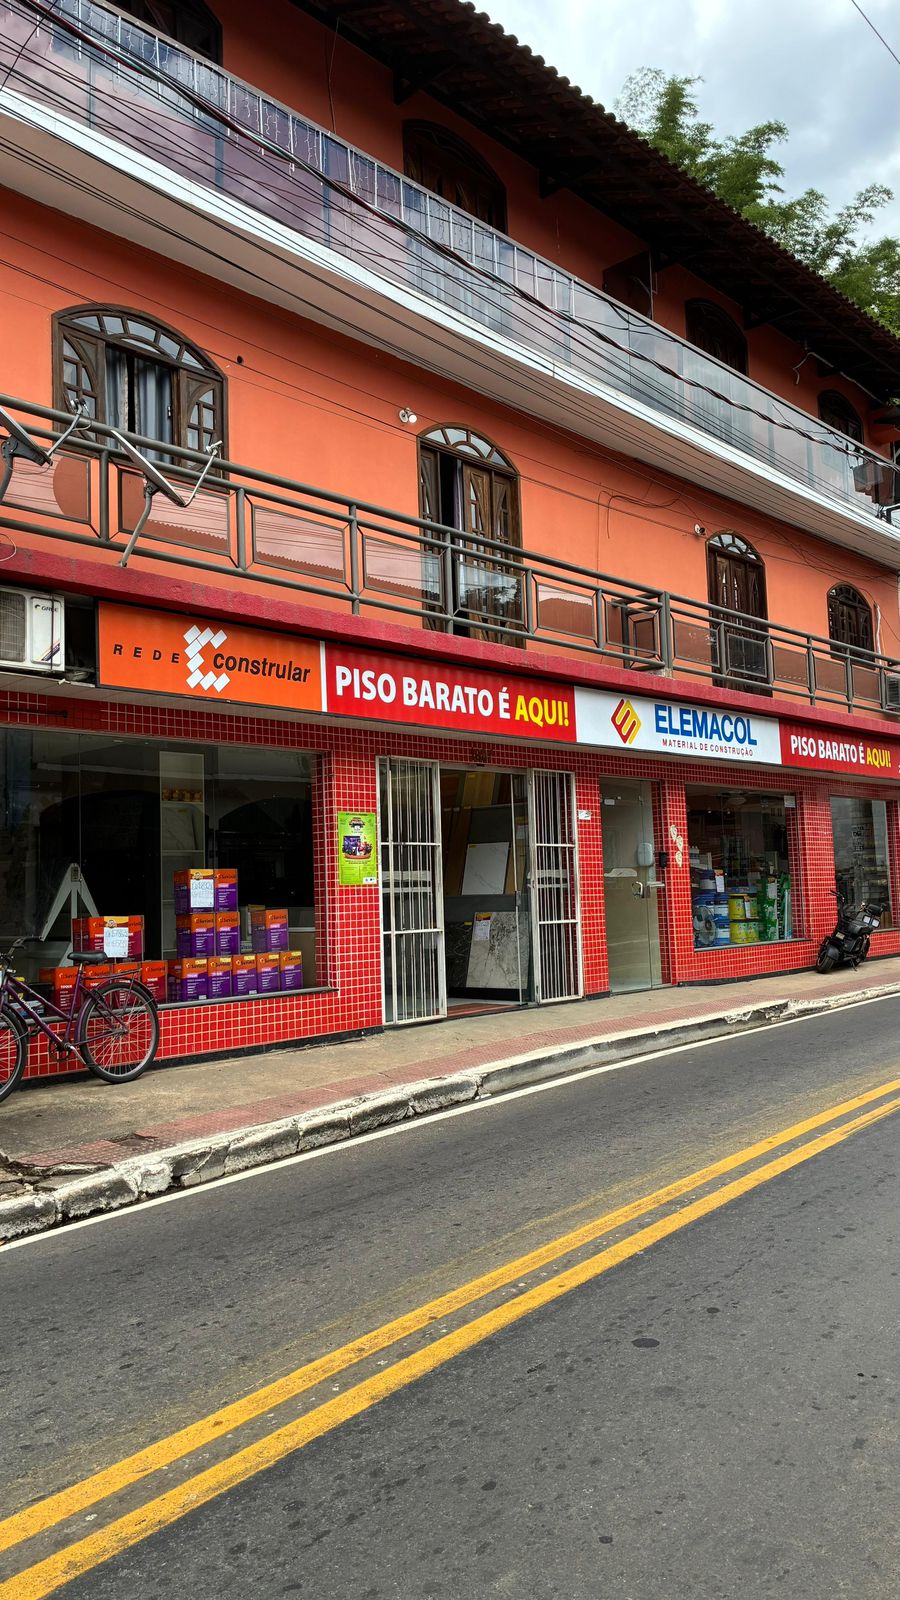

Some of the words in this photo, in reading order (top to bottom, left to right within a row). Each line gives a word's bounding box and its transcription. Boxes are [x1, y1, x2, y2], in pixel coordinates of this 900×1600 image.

[113, 643, 180, 664] REDE
[213, 652, 311, 683] constrular
[335, 665, 397, 704] PISO
[402, 676, 494, 717] BARATO
[498, 686, 511, 720] É
[514, 694, 570, 727] AQUI!
[654, 704, 757, 746] ELEMACOL
[662, 739, 698, 750] MATERIAL
[700, 742, 709, 752] DE
[710, 744, 754, 757] CONSTRUÇÃO
[790, 734, 817, 758] PISO
[818, 739, 858, 763] BARATO
[858, 742, 865, 764] É
[866, 747, 892, 768] AQUI!
